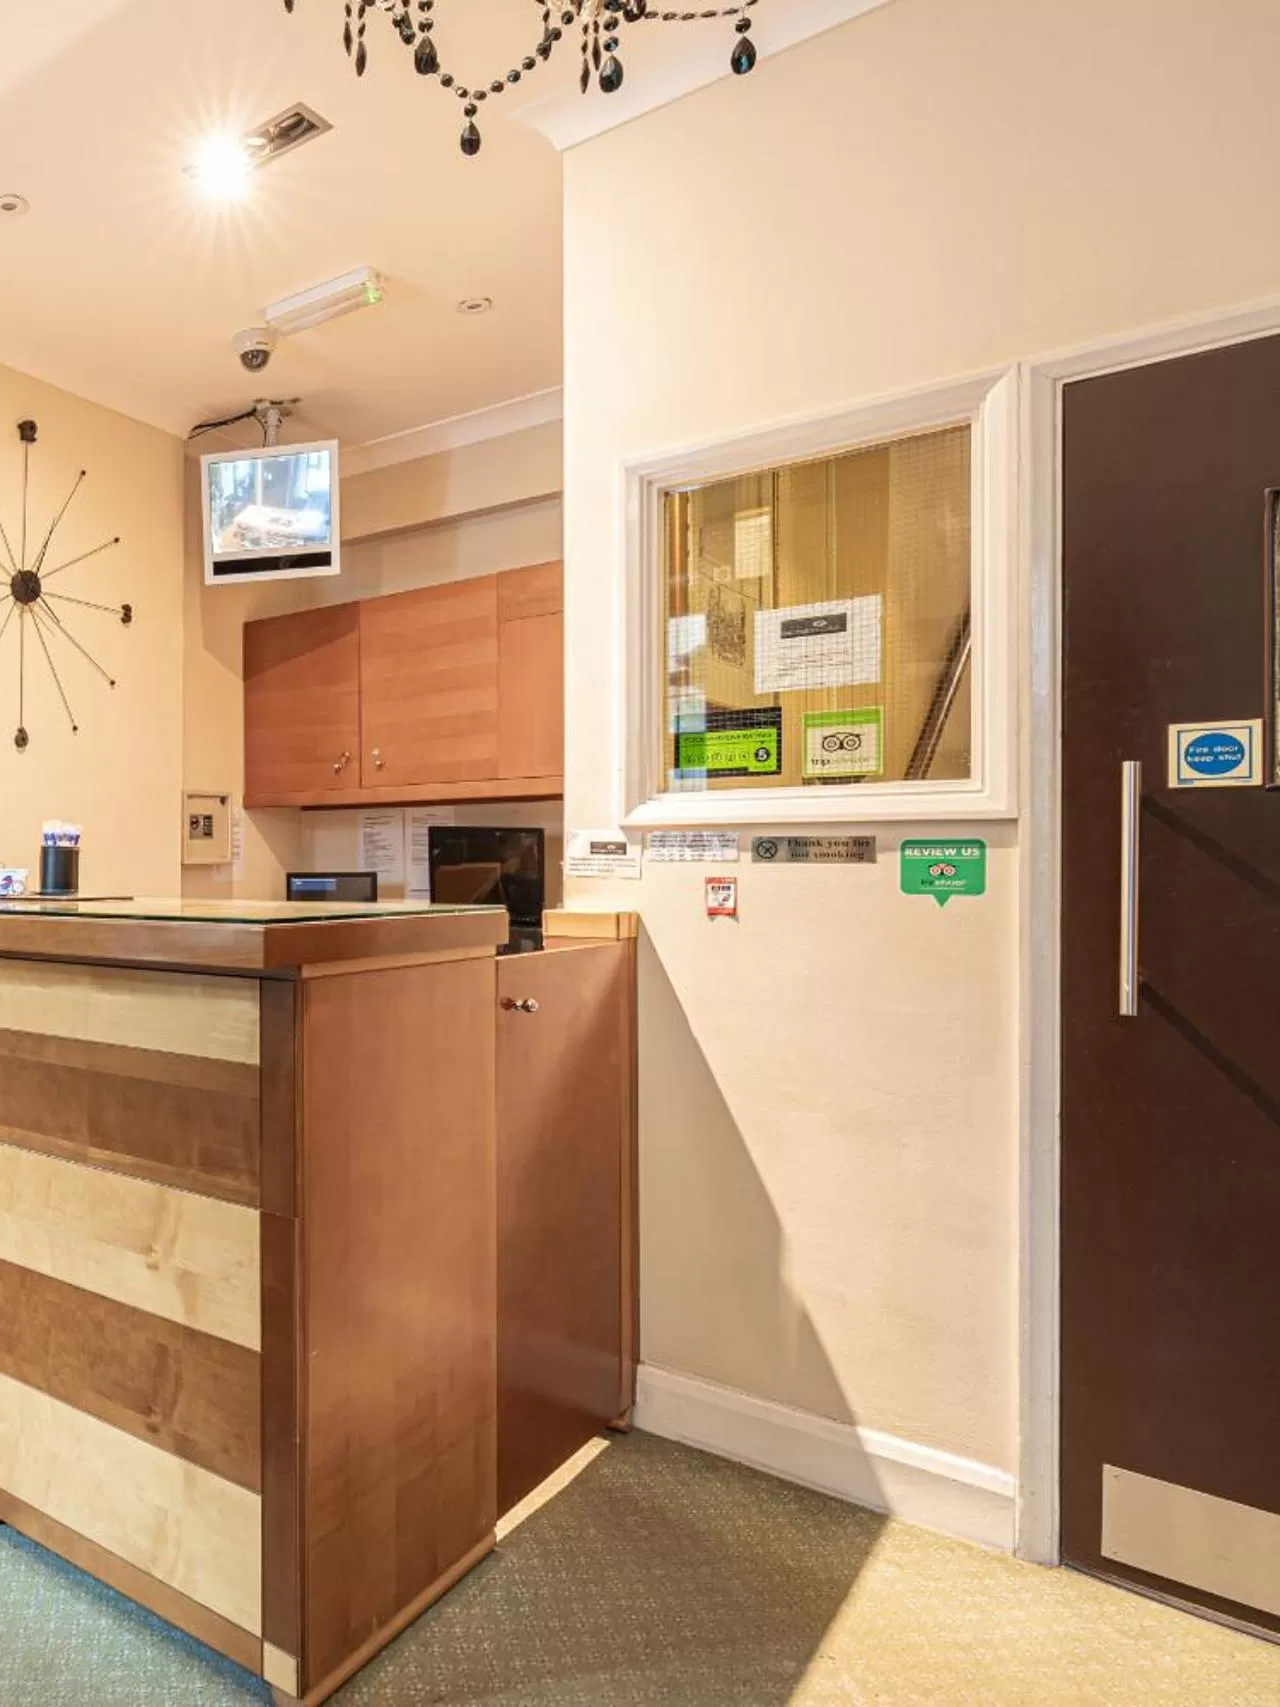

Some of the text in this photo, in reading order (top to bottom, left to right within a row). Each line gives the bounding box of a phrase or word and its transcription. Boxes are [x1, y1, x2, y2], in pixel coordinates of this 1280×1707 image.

[1212, 745, 1238, 753] door
[1187, 755, 1214, 763] keep
[826, 840, 850, 849] you
[961, 847, 981, 857] US
